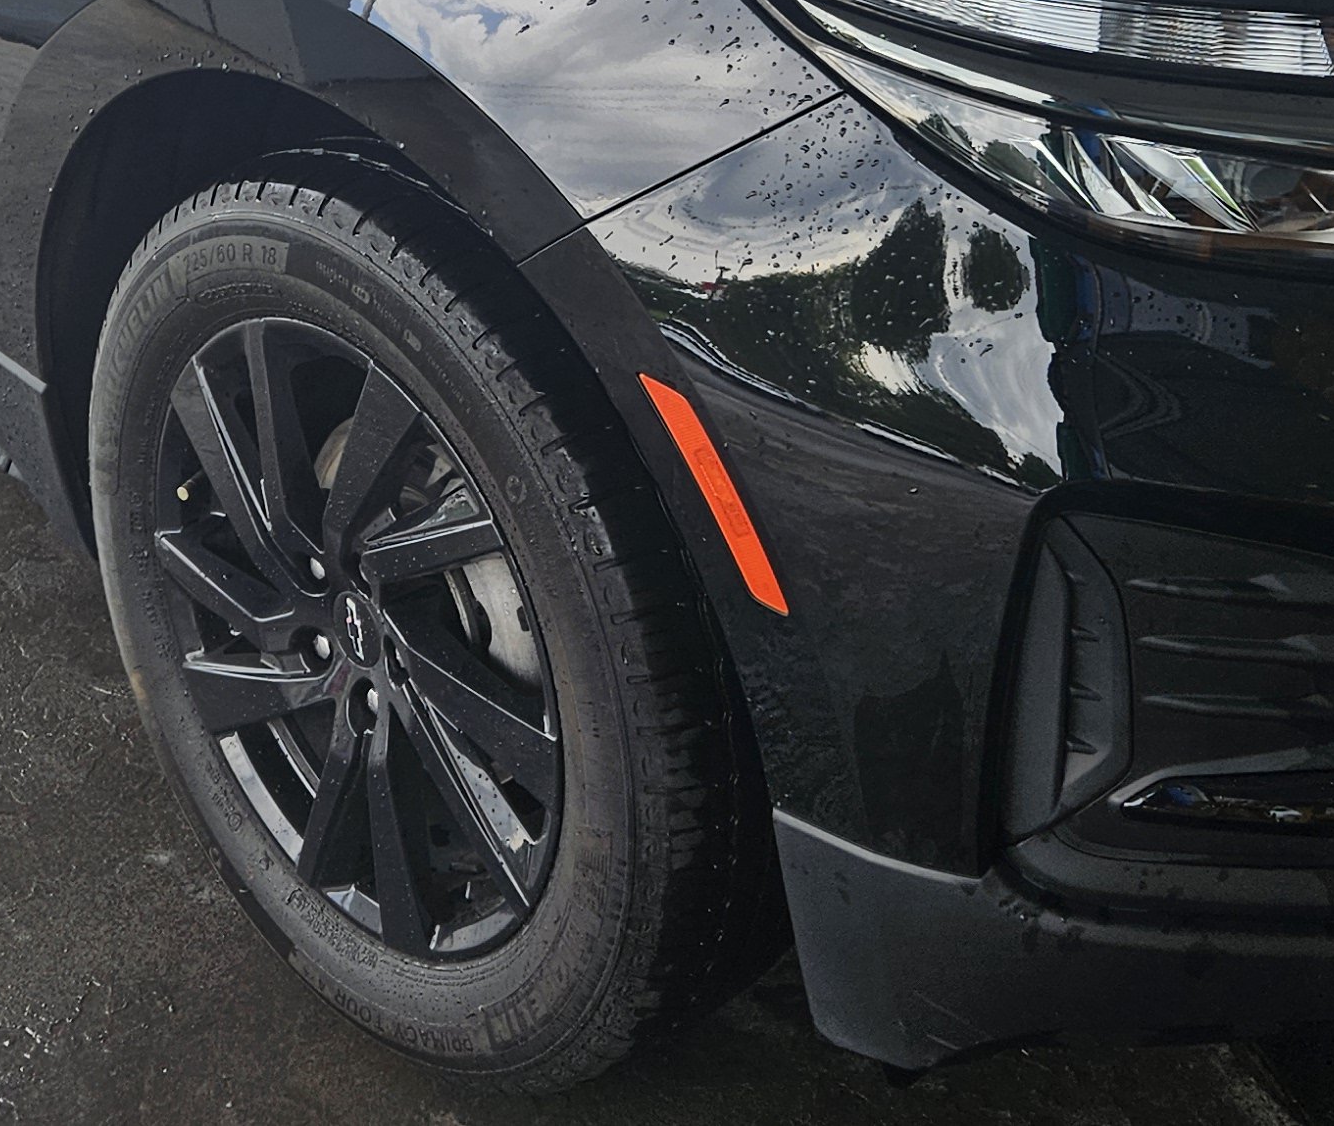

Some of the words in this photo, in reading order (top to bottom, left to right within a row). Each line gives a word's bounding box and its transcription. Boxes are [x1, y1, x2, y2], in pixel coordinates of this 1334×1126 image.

[183, 243, 236, 273] 225/60
[242, 243, 253, 263] R
[260, 245, 278, 265] 18
[334, 986, 385, 1033] TOUR
[392, 1019, 475, 1053] PRIMACY
